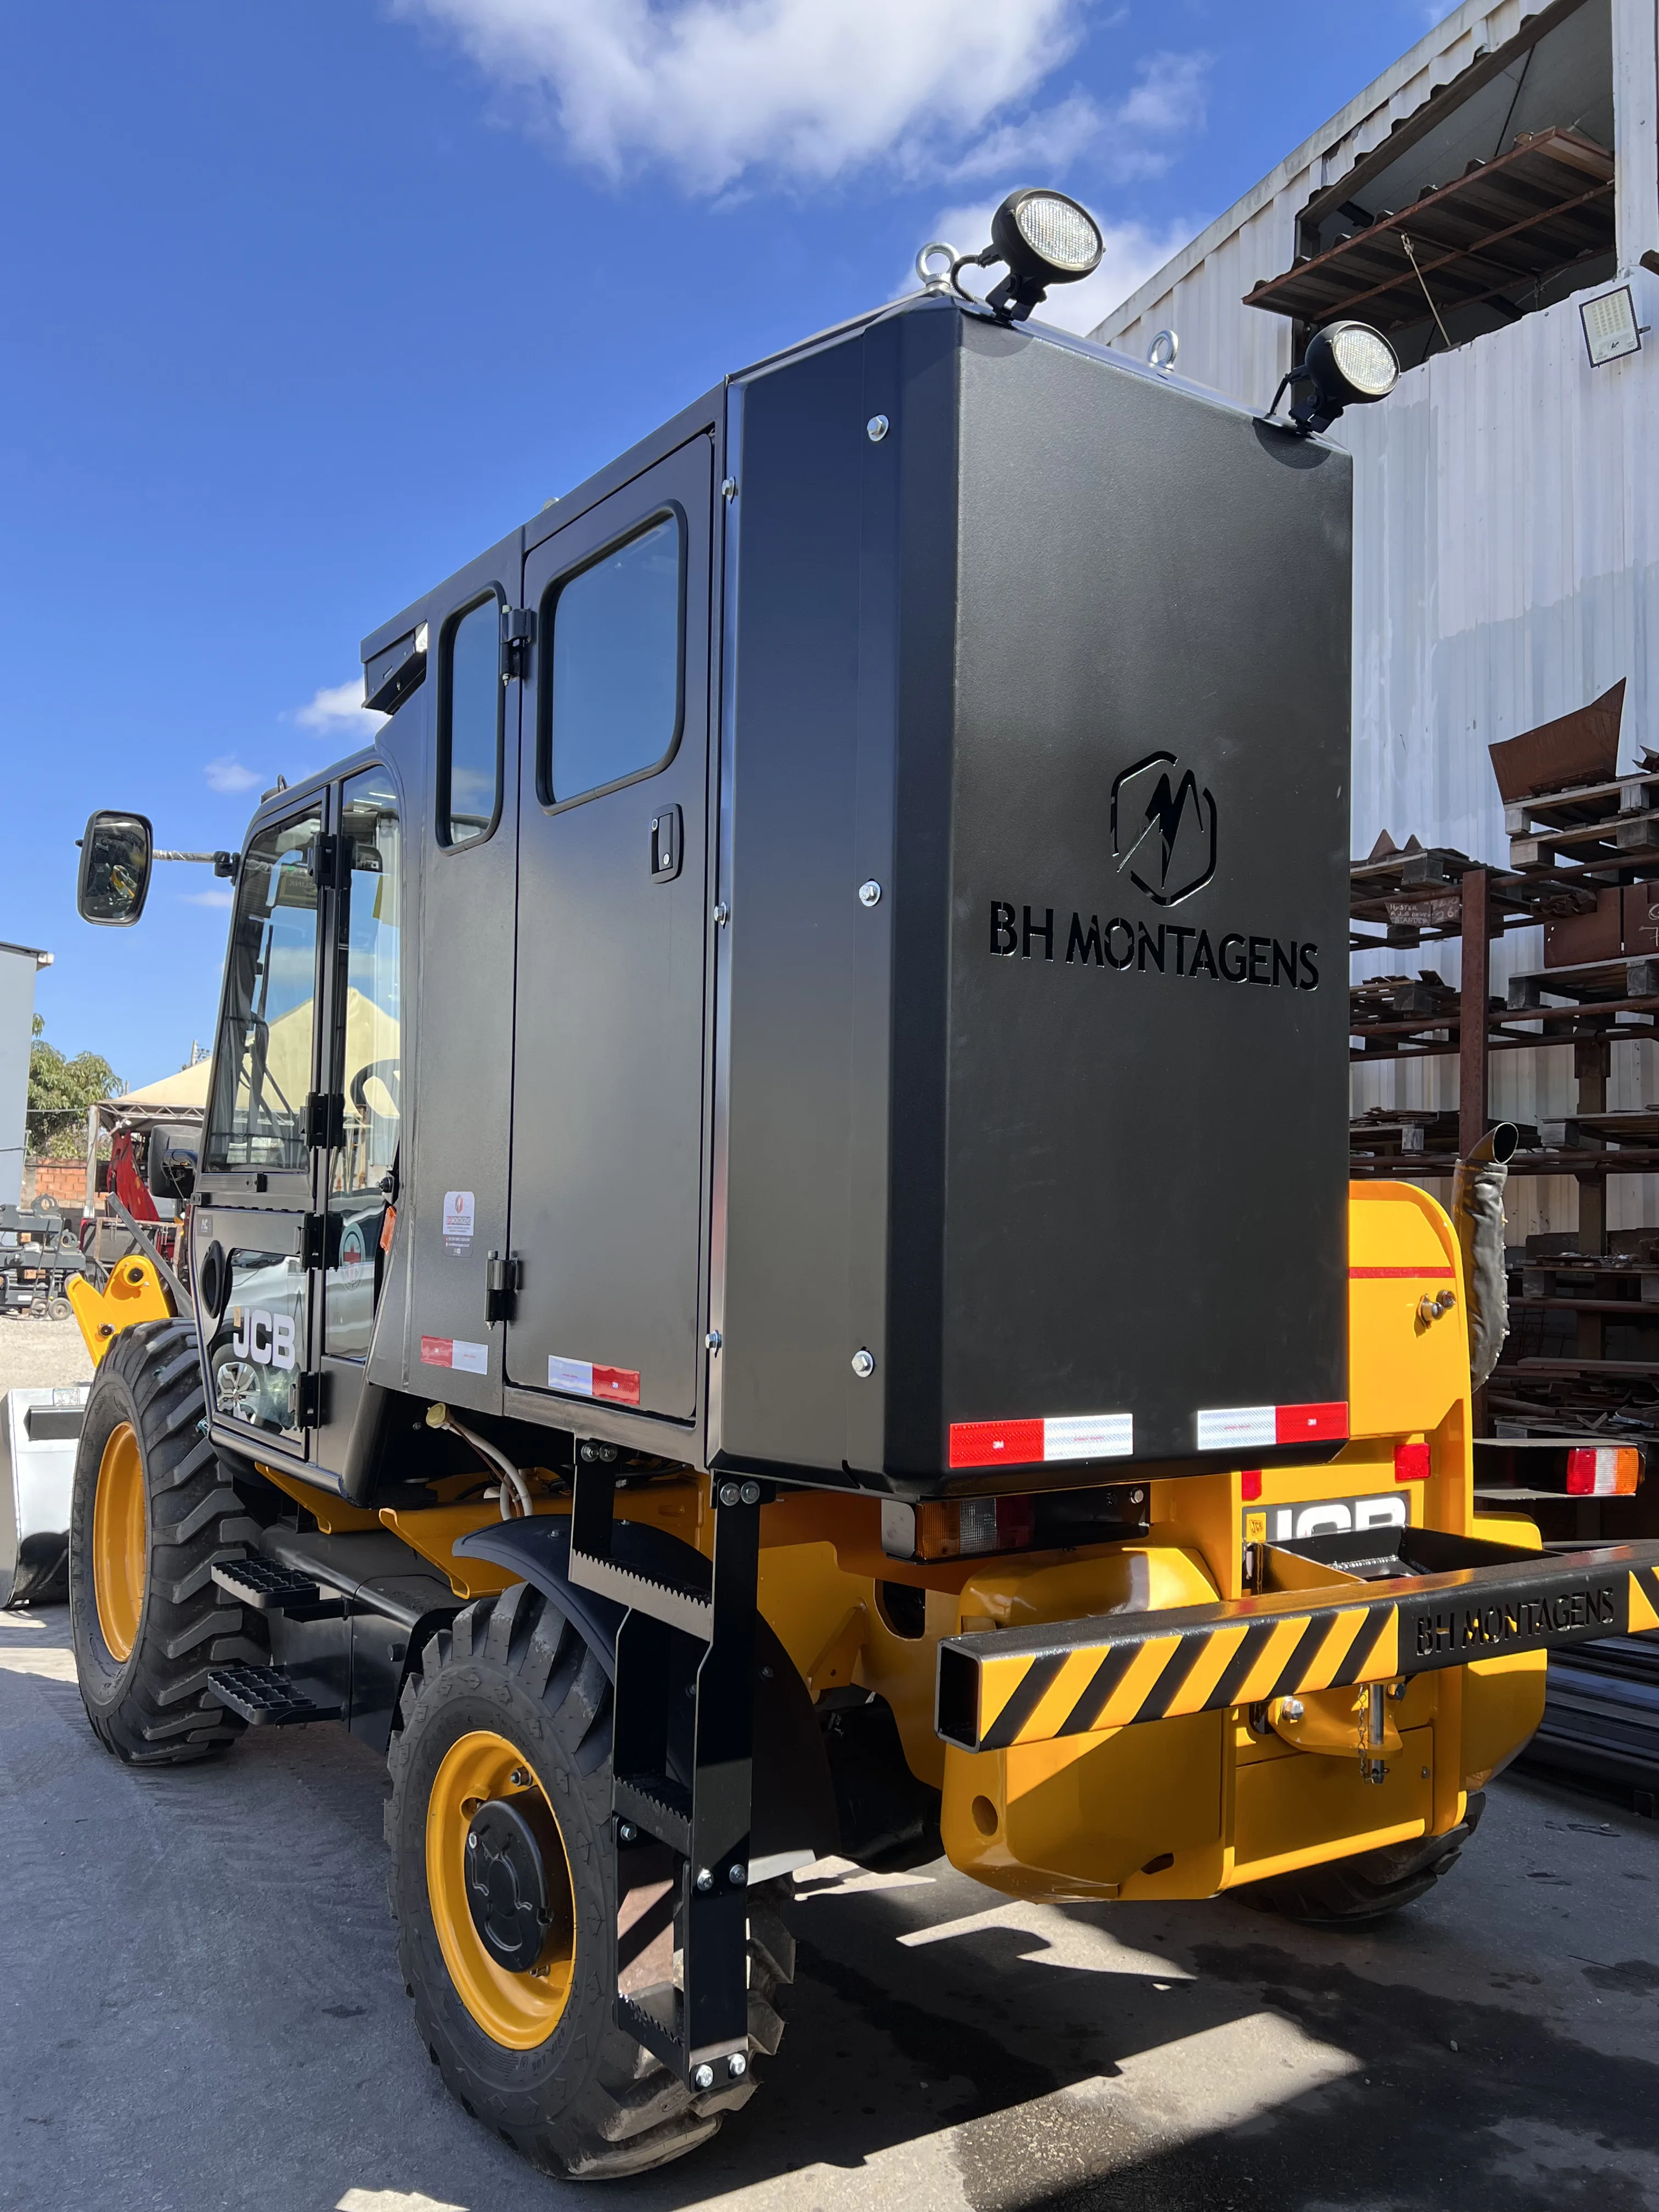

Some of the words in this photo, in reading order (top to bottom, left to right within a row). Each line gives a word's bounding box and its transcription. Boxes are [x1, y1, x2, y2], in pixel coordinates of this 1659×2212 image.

[990, 900, 1054, 962] BH
[1064, 912, 1319, 992] MONTAGENS
[233, 1307, 296, 1370] JCB
[1251, 1521, 1263, 1533] JCB
[1416, 1612, 1455, 1656] BH
[1461, 1587, 1615, 1649] MONTAGENS
